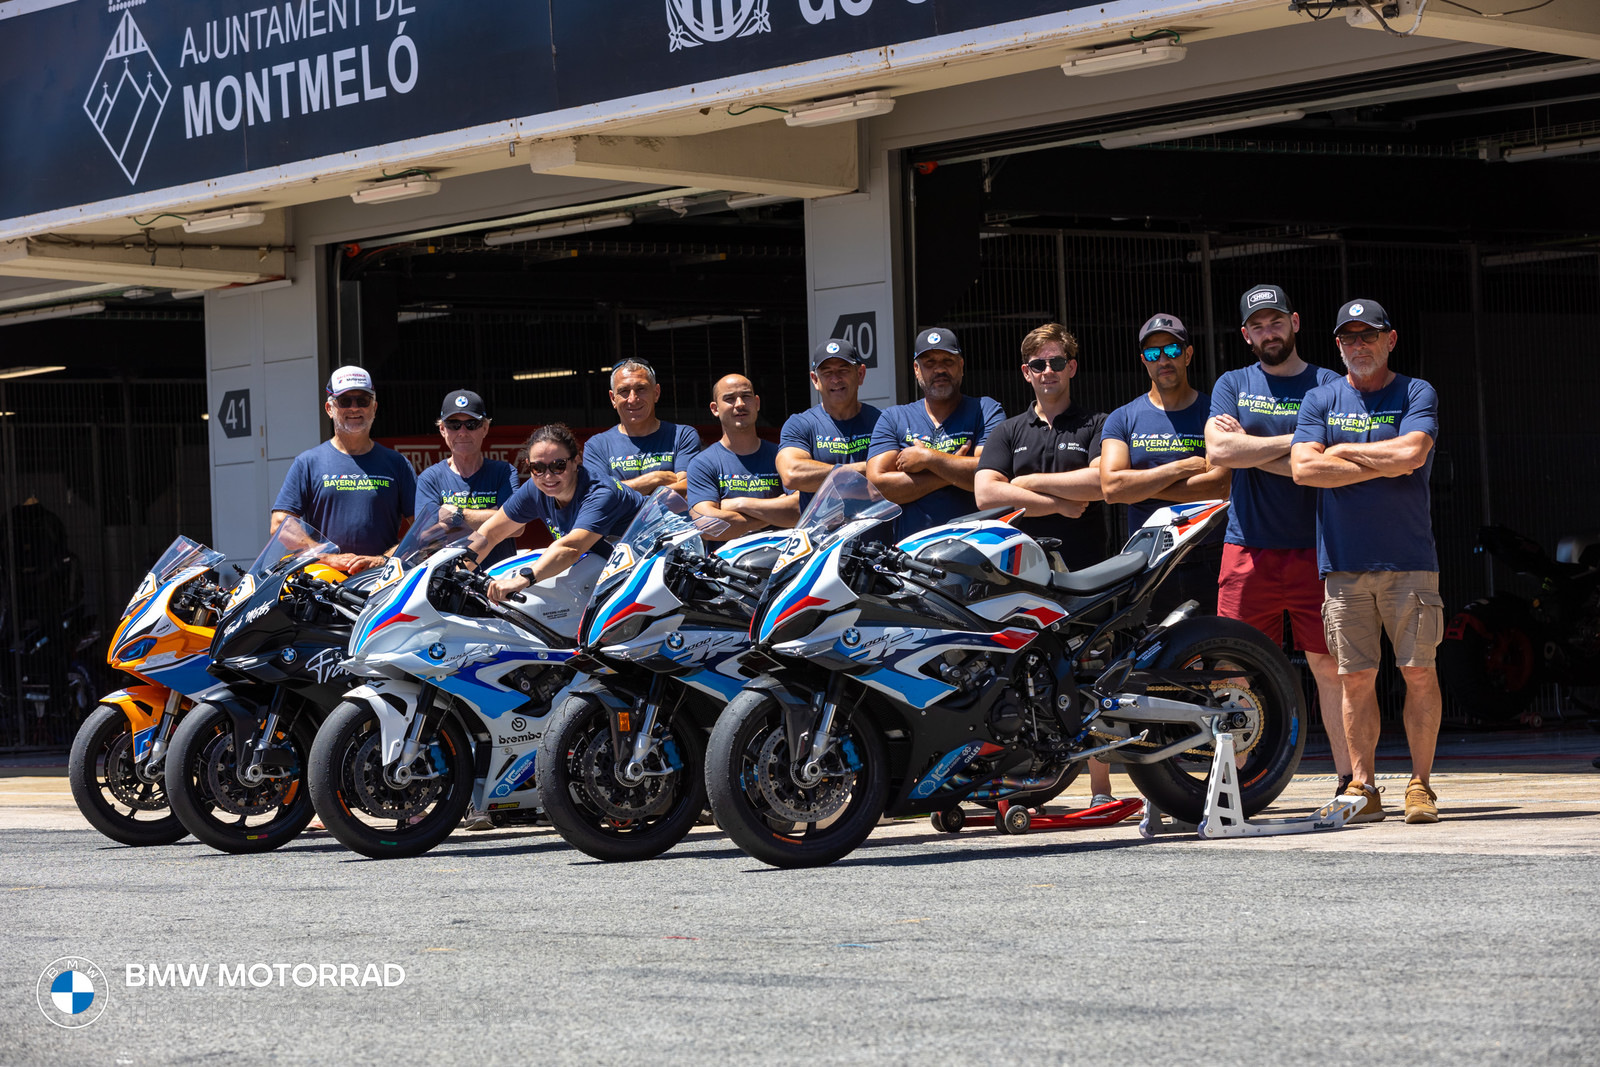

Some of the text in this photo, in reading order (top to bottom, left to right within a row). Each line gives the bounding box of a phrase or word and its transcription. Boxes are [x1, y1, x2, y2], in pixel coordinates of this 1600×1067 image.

[182, 21, 419, 140] MONTMELÓ
[1237, 399, 1274, 411] BAYERN
[225, 397, 247, 430] 41
[1327, 417, 1365, 428] BAYERN
[816, 441, 848, 450] BAYERN
[1132, 439, 1169, 448] BAYERN
[611, 455, 673, 470] BAYERN AVENUE
[323, 479, 390, 488] BAYERN AVENUE
[720, 478, 780, 488] BAYERN AVENUE
[498, 731, 543, 745] brembo
[963, 745, 982, 765] GILLES
